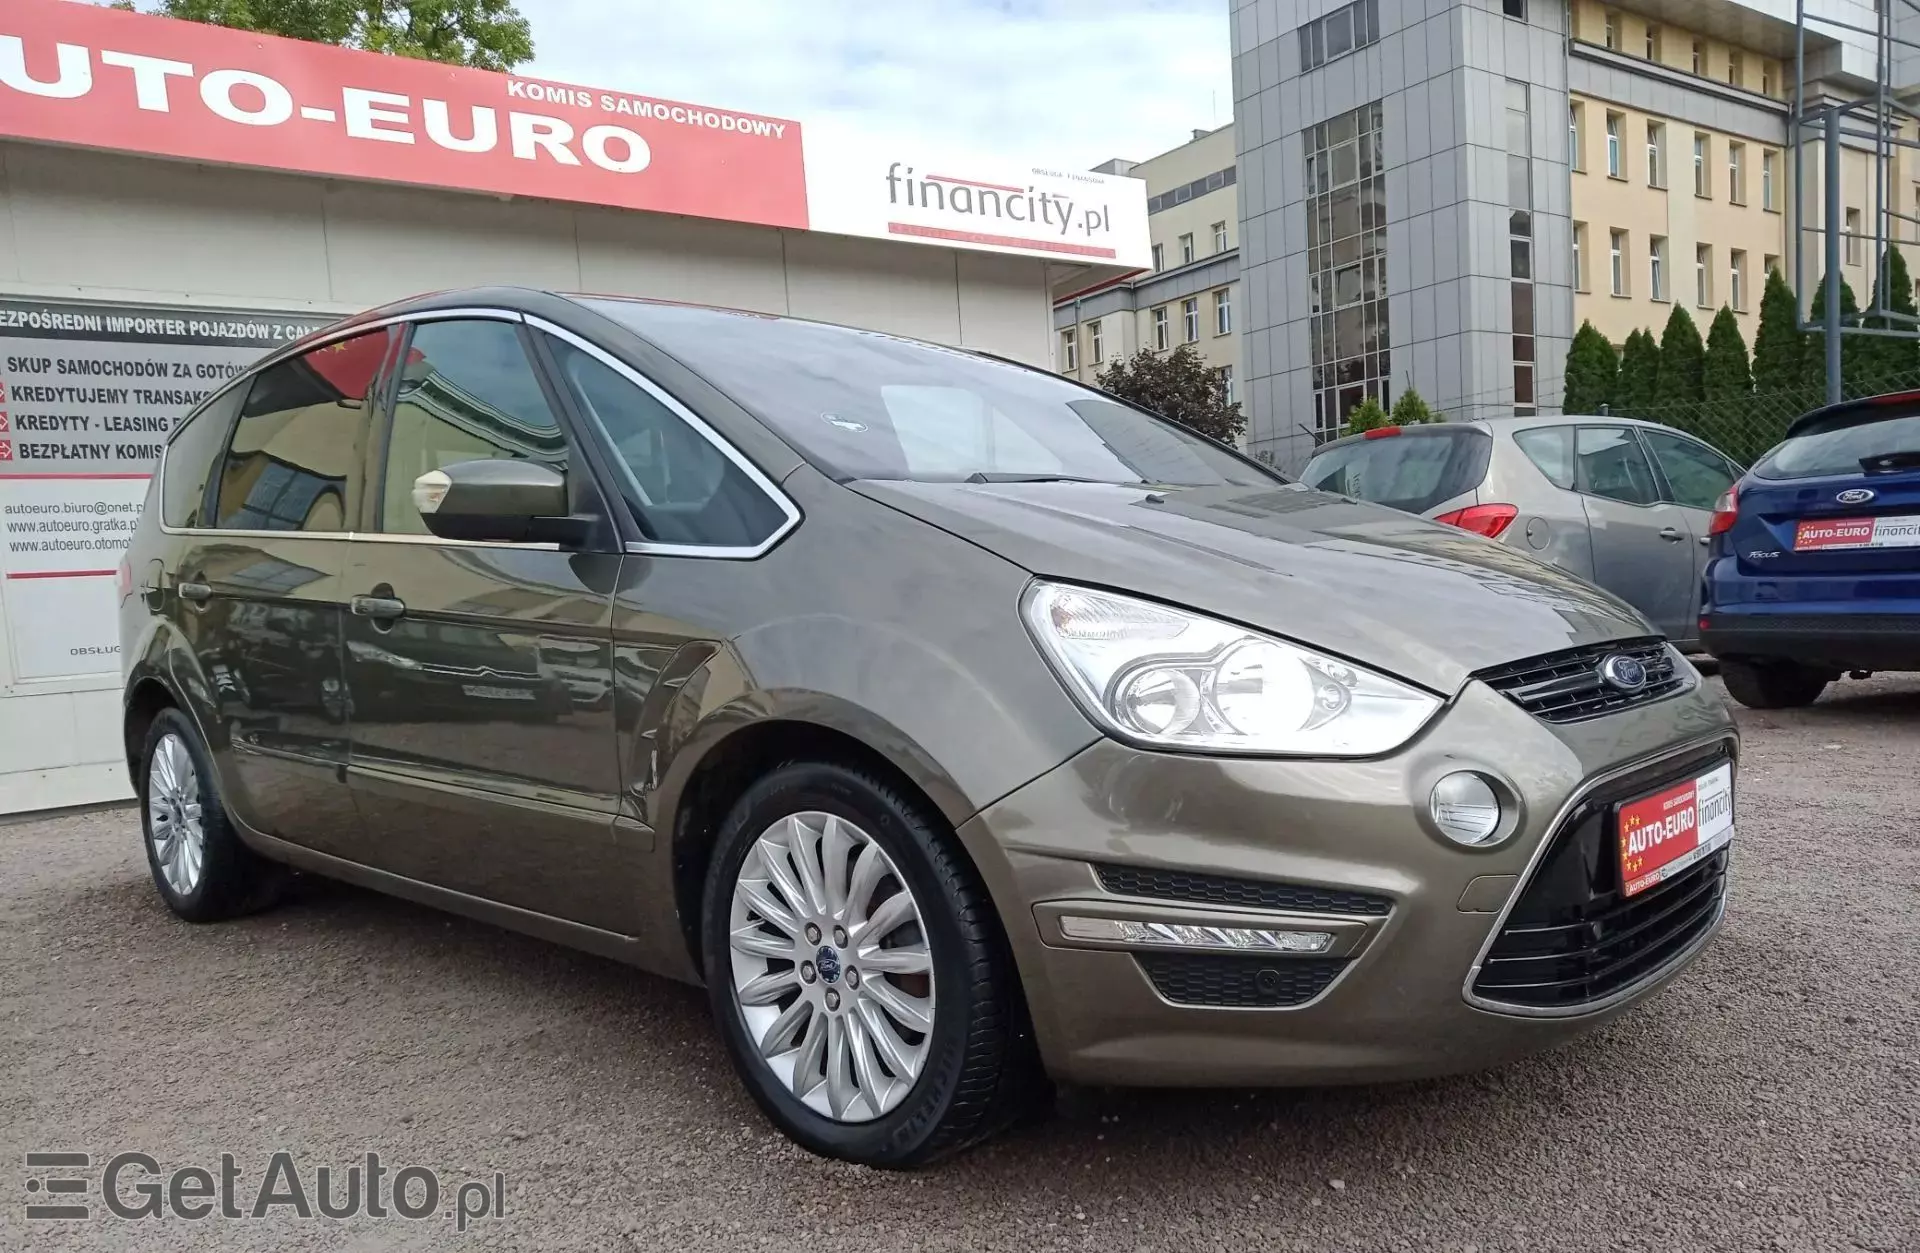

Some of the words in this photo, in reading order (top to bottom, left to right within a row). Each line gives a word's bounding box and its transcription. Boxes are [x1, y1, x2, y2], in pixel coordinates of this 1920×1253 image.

[507, 80, 592, 108] KOMIS
[600, 94, 786, 139] SAMOCHODOWY
[886, 162, 1110, 236] financity.pl
[106, 316, 187, 335] IMPORTER
[190, 320, 269, 339] POJAZDÓW
[272, 324, 283, 339] Z
[7, 356, 52, 374] SKUP
[57, 358, 168, 378] SAMOCHODÓW
[172, 363, 192, 378] ZA
[11, 386, 129, 404] KREDYTUJEMY
[15, 415, 89, 431] KREDYTY
[104, 416, 169, 432] LEASING
[19, 443, 111, 460] BEZPŁATNY
[116, 444, 162, 460] KOMIS
[7, 518, 139, 534] www.autoeuro.gratka.p
[1803, 526, 1870, 539] AUTO-EURO
[1628, 806, 1695, 857] AUTO-EURO
[1629, 872, 1660, 893] AUTO-EURO
